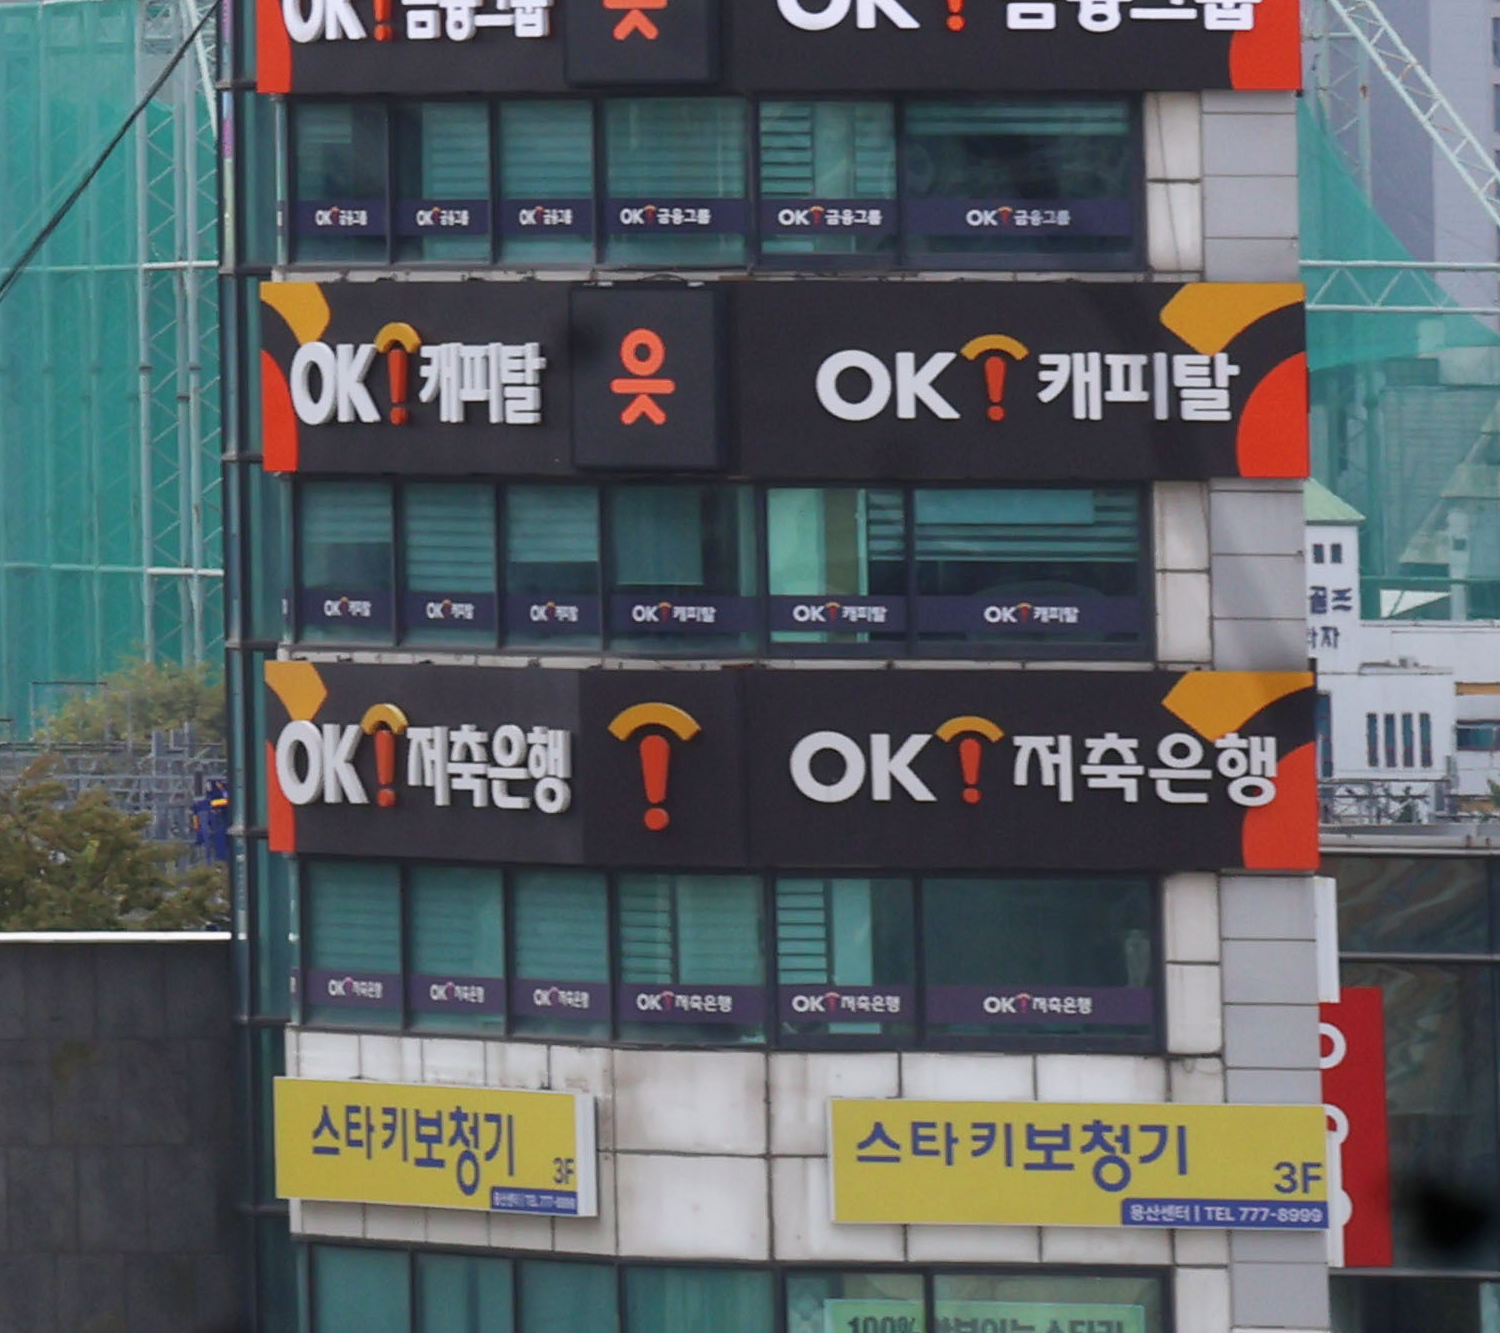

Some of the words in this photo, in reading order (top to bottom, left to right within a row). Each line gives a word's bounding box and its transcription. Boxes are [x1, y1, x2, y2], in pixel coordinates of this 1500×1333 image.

[419, 342, 547, 425] 캐피탈
[1037, 351, 1241, 421] 캐피탈
[406, 724, 571, 813] 저축은행
[1012, 733, 1278, 807] 저축은행
[312, 1105, 514, 1196] 스타키보청기
[553, 1157, 575, 1185] 3F
[856, 1120, 1188, 1193] 스타키보청기
[1273, 1161, 1324, 1194] 3F
[1129, 1203, 1190, 1222] 용산센터
[1204, 1206, 1237, 1222] TEL
[1239, 1207, 1323, 1223] 777-8999
